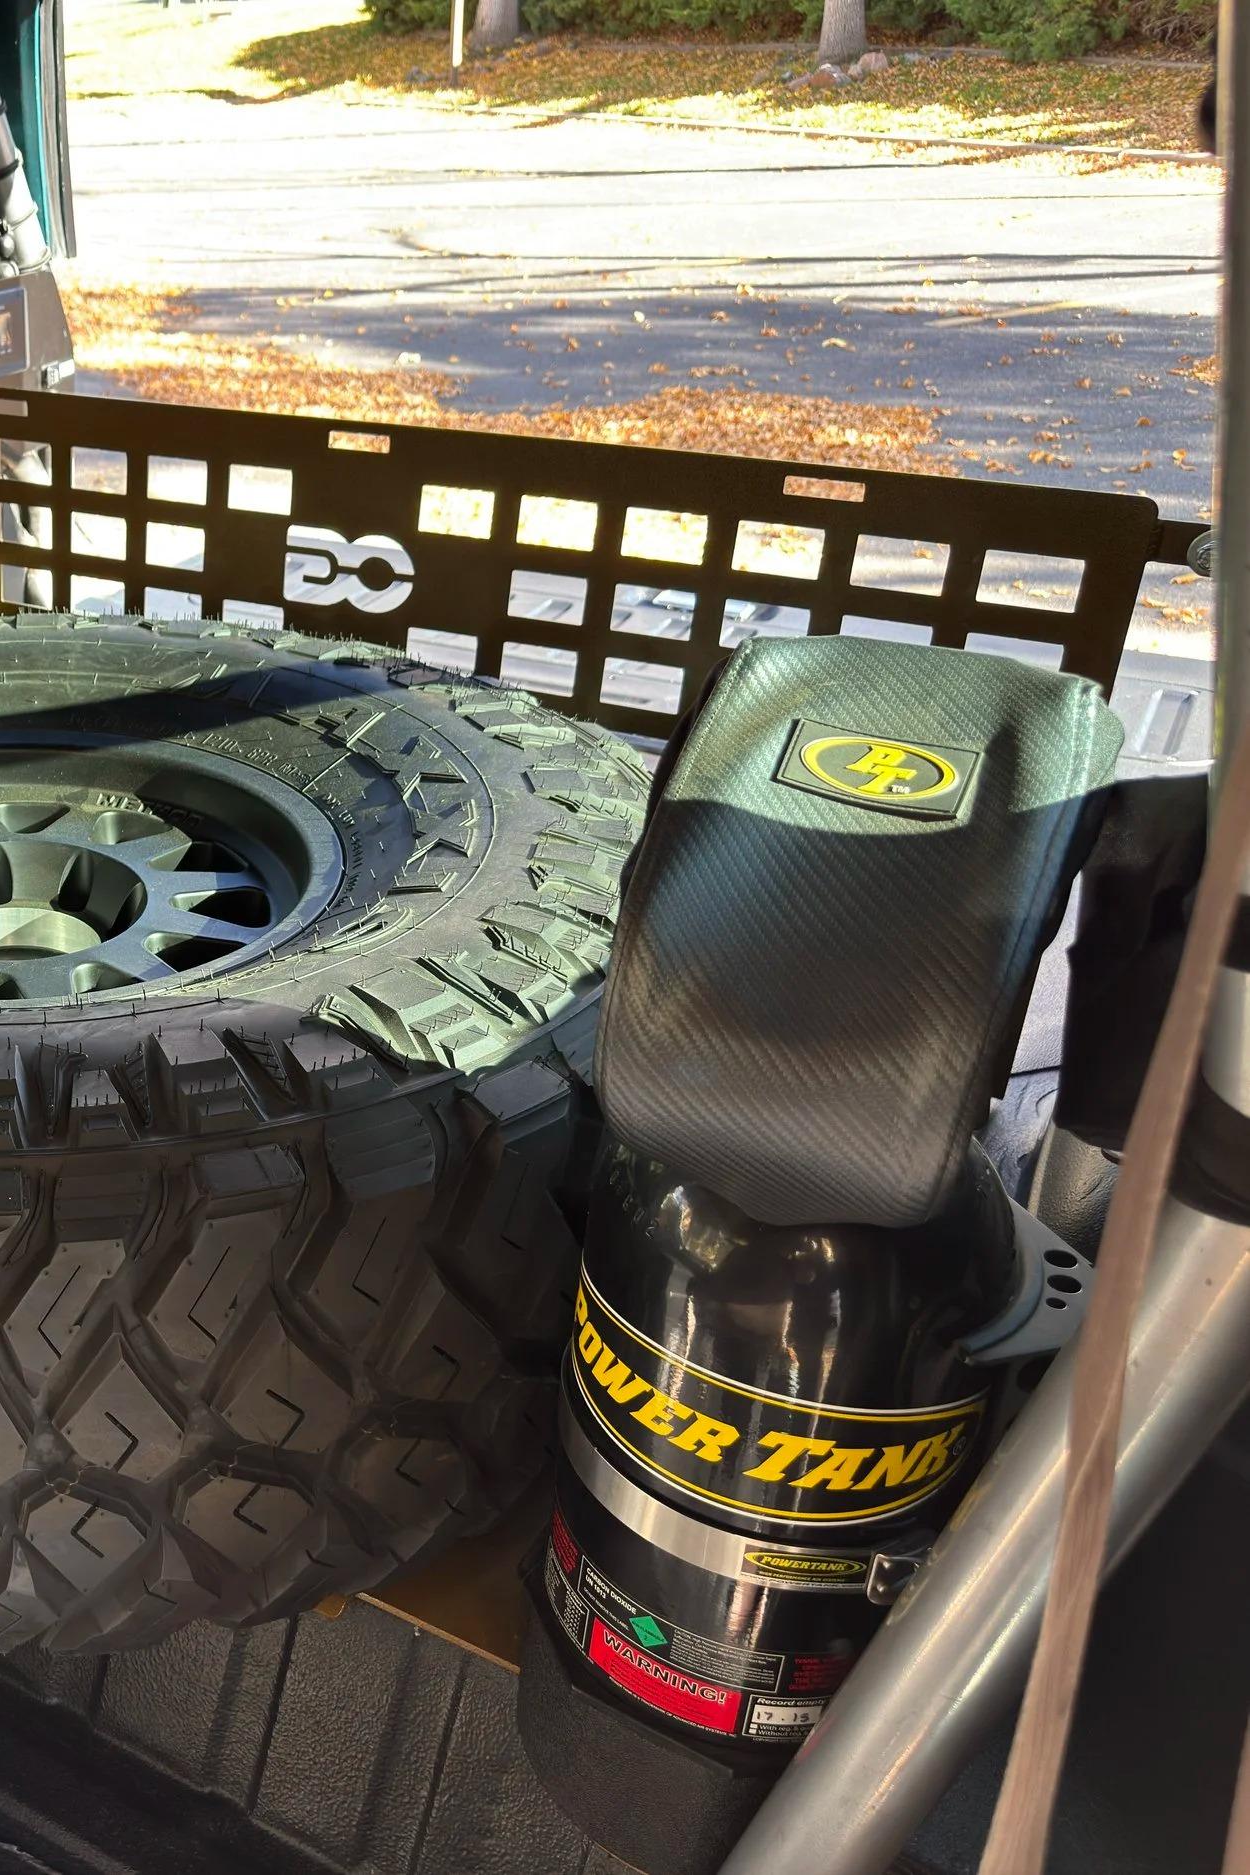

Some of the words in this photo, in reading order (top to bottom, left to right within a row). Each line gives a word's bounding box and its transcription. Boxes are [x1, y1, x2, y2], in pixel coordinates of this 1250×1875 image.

[575, 1281, 741, 1463] POWER
[743, 1423, 967, 1492] TANK
[760, 1556, 848, 1571] POWERTANK
[586, 1567, 610, 1594] CARBON
[610, 1591, 637, 1615] DIOXIDE
[603, 1628, 727, 1705] WARNING!
[757, 1697, 795, 1706] Record
